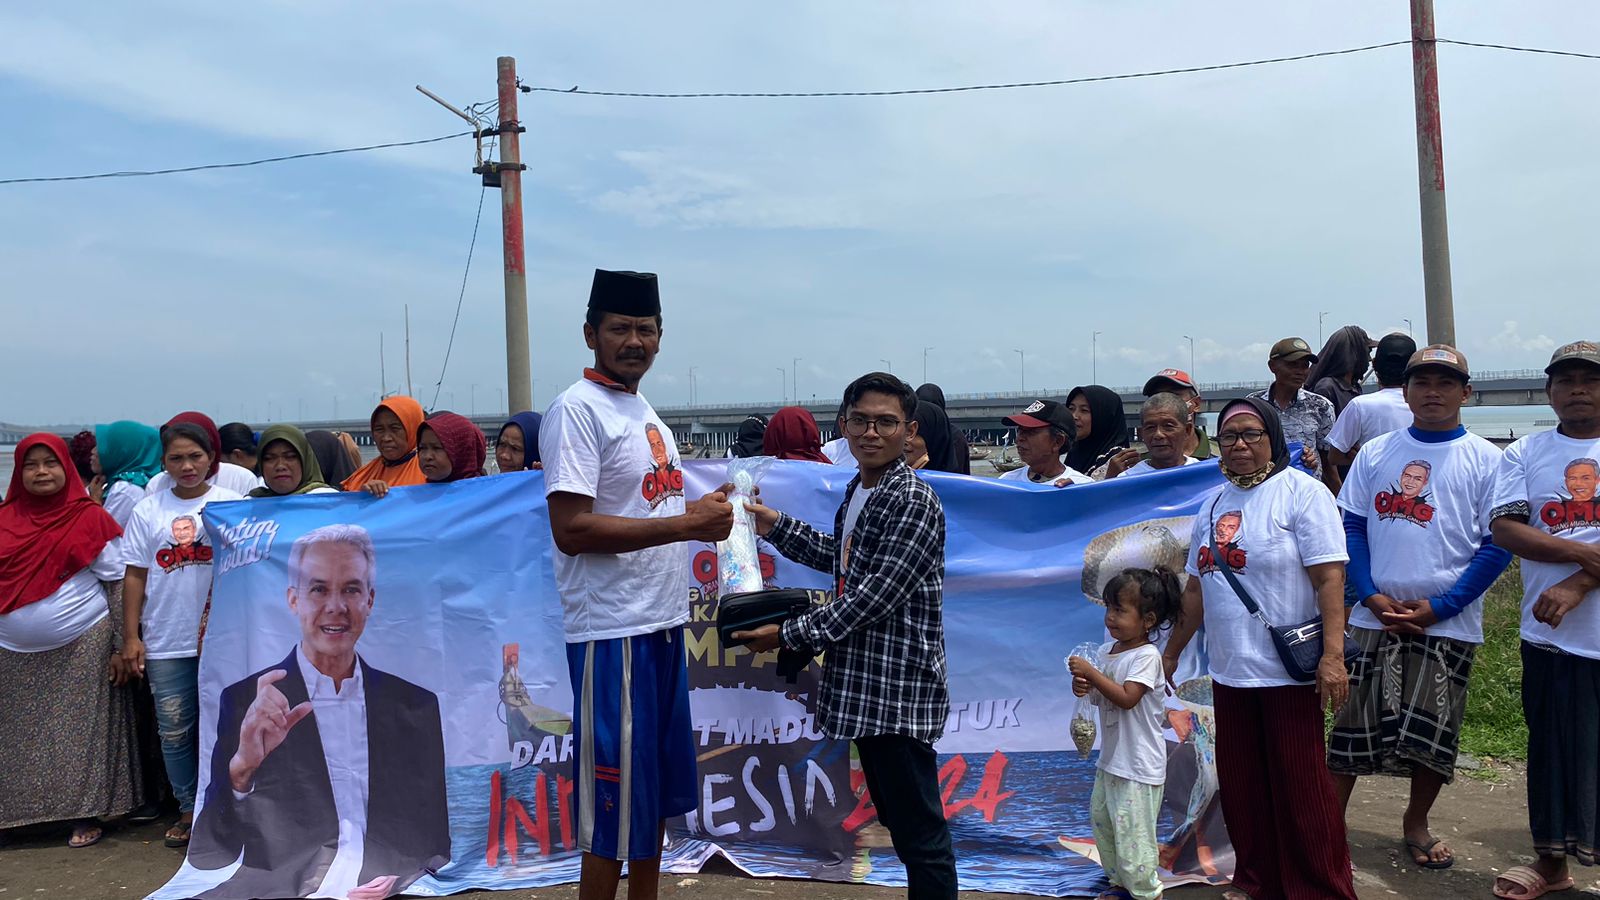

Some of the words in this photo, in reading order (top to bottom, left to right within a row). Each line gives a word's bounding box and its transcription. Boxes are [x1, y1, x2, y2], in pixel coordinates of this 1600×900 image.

[642, 469, 682, 501] OMG
[1375, 491, 1433, 521] OMG
[1540, 501, 1600, 526] OM
[156, 543, 212, 567] OMG
